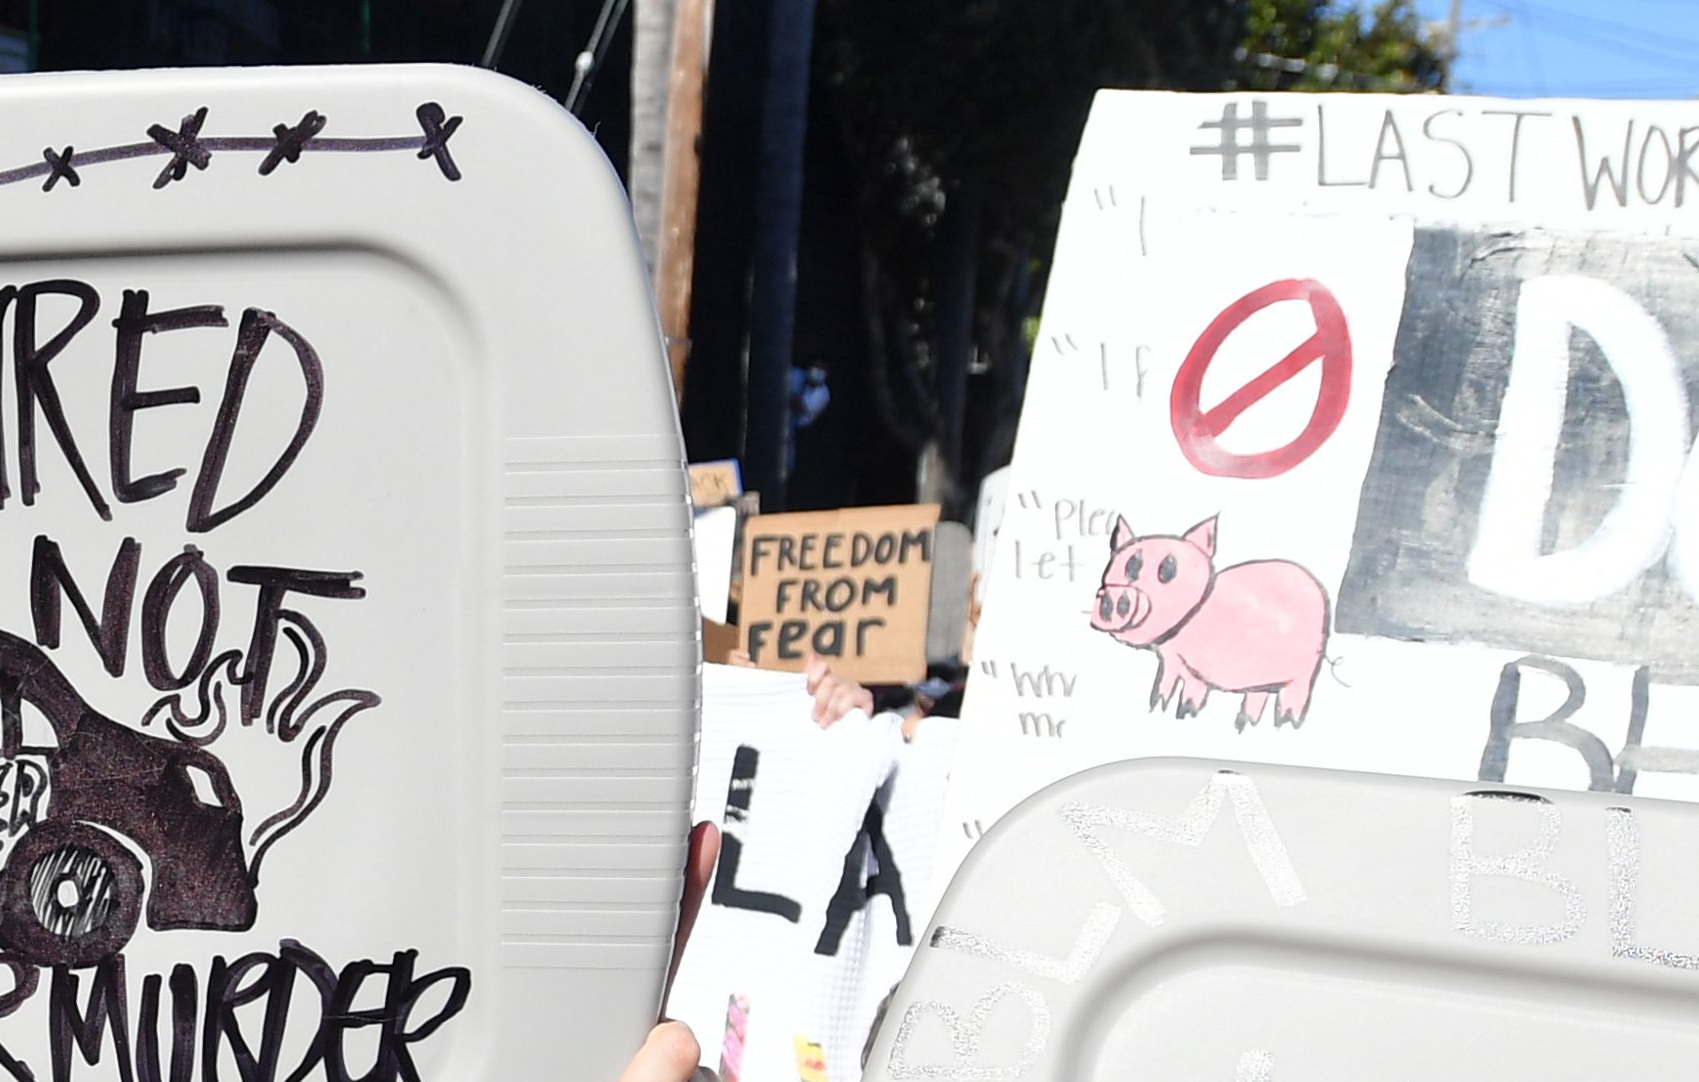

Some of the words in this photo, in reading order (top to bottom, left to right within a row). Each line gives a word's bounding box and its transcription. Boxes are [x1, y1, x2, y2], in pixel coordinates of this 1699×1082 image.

[750, 527, 933, 576] FREEDOM
[776, 575, 899, 614] FROM
[30, 535, 366, 723] NOT
